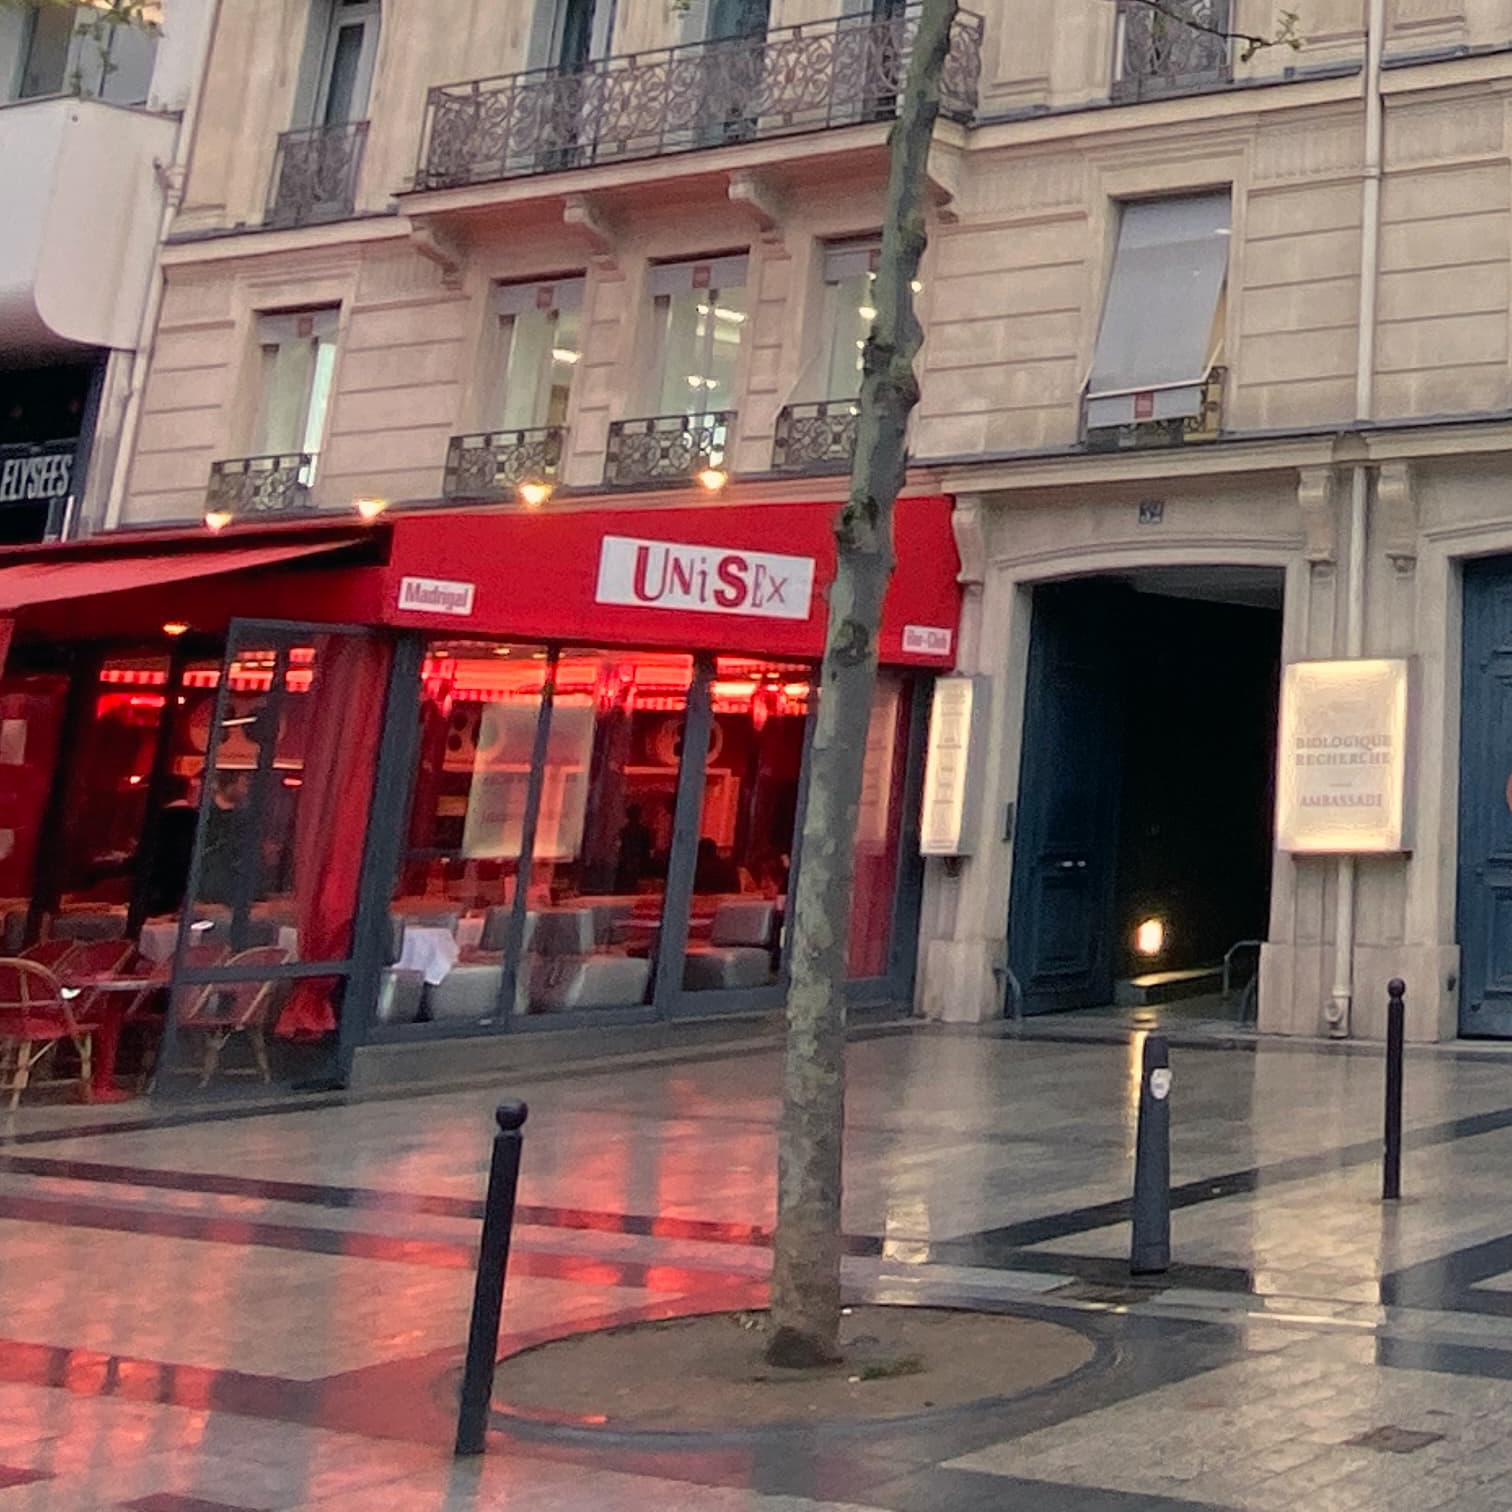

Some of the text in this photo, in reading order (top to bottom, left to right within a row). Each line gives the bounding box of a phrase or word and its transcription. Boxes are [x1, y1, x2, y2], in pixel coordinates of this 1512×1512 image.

[404, 582, 470, 611] Madrigal
[1295, 734, 1392, 751] BIOLOGIQUE
[1295, 751, 1391, 766] RECHERCHE
